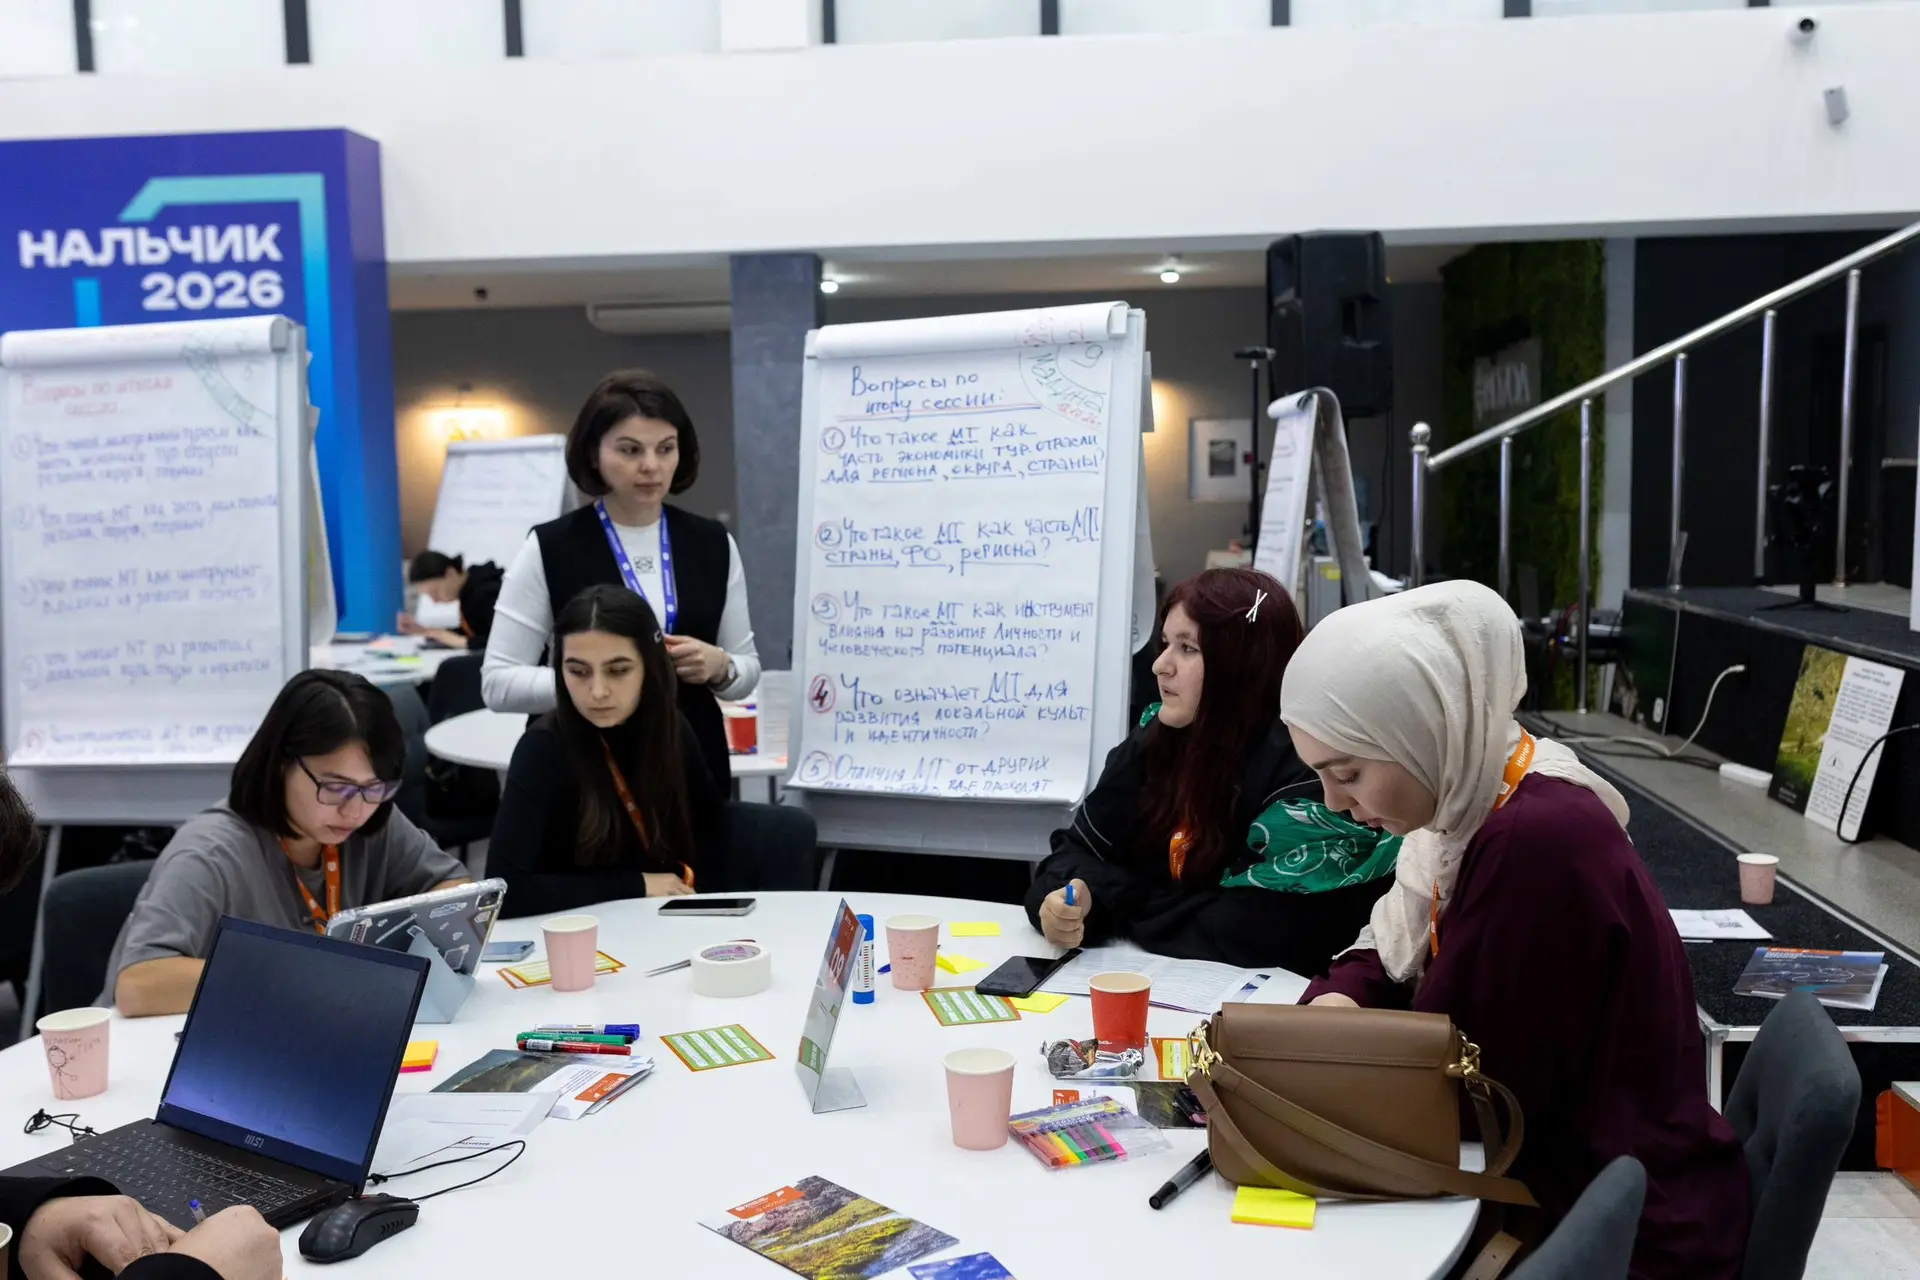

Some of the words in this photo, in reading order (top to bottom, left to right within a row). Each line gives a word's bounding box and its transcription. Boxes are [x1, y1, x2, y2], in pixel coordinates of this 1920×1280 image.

[18, 223, 284, 268] НАЛЬЧИК
[141, 269, 285, 311] 2026
[851, 365, 946, 402] Вопросы
[956, 373, 979, 386] по
[851, 426, 882, 448] Что
[885, 431, 938, 446] такое
[951, 427, 980, 441] МТ
[990, 423, 1036, 441] как
[843, 516, 869, 548] Что
[872, 526, 927, 541] такое
[937, 522, 966, 541] МТ
[977, 520, 1015, 538] как
[843, 590, 873, 621] Что
[882, 603, 931, 619] такое
[936, 601, 964, 619] МТ
[973, 602, 1007, 618] как
[840, 672, 884, 711] Что
[893, 685, 981, 703] означает
[986, 671, 1024, 701] МТ
[955, 762, 980, 776] от
